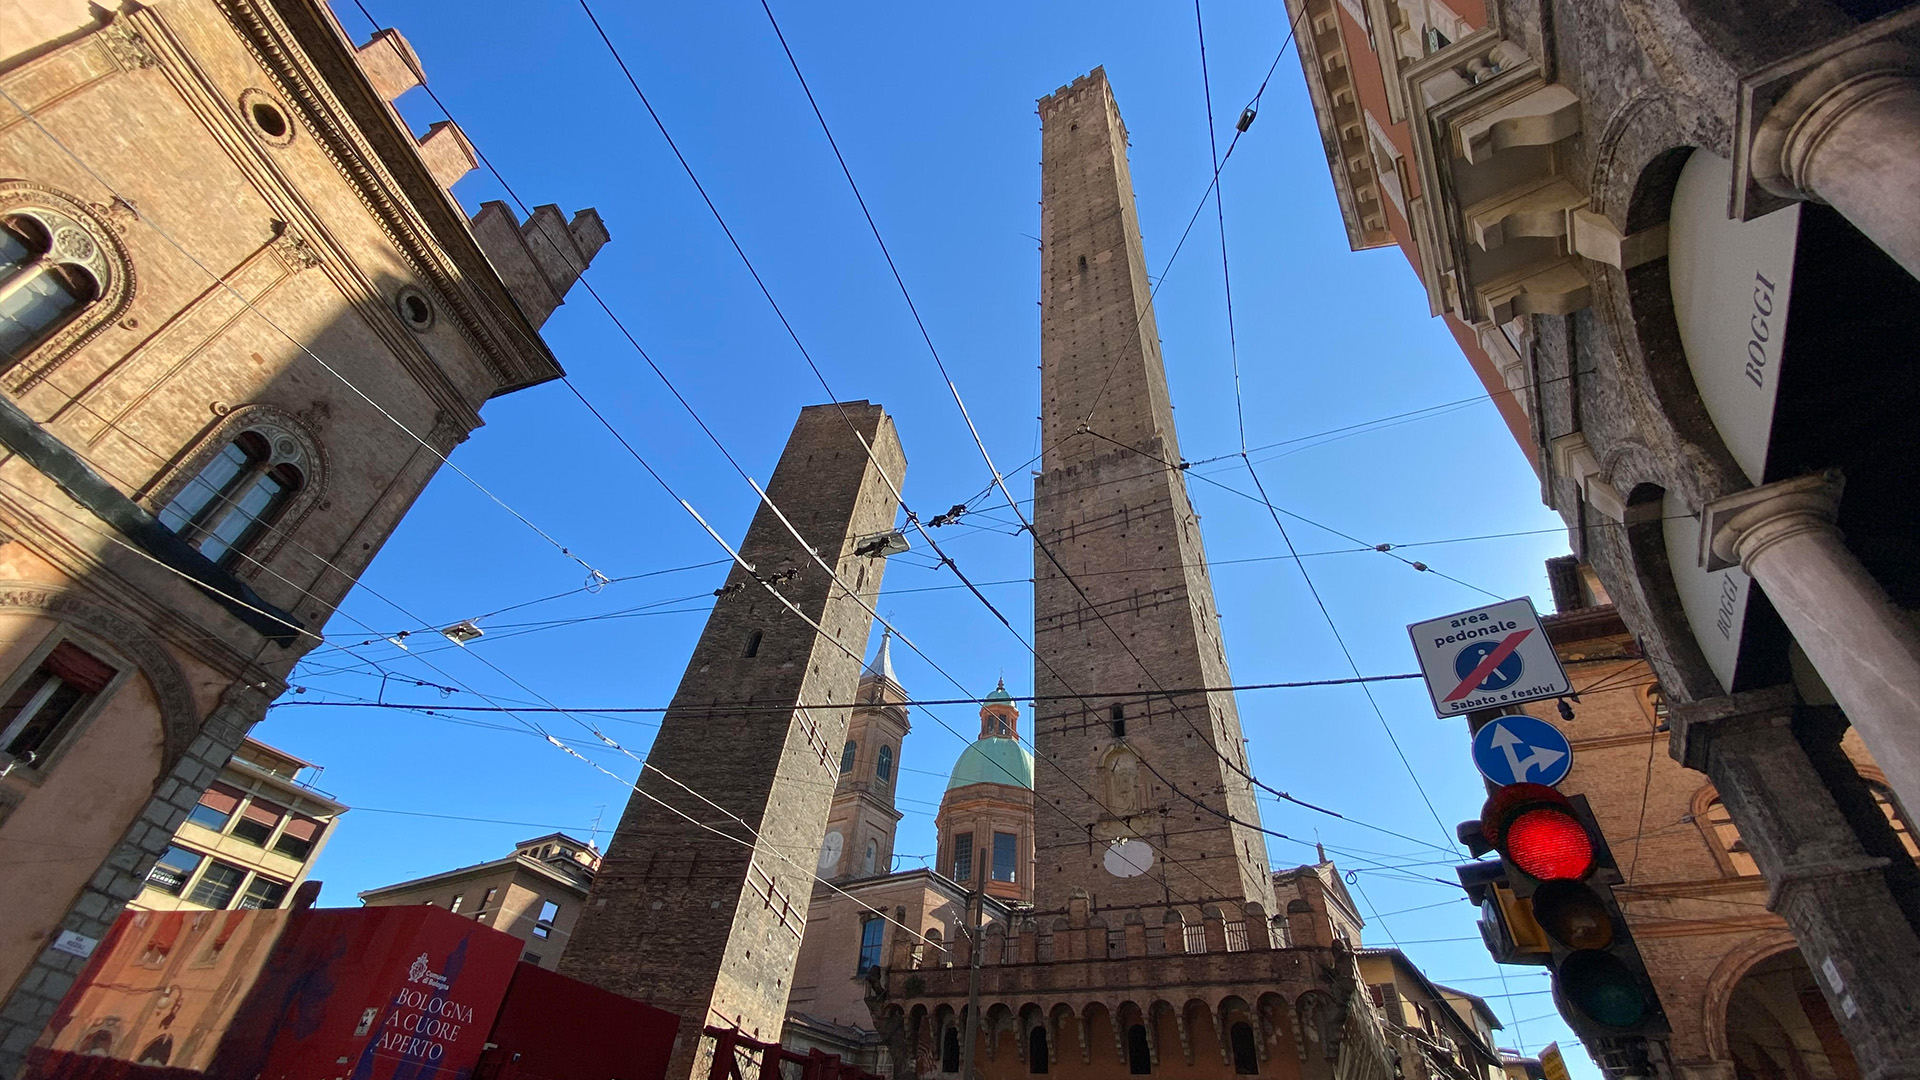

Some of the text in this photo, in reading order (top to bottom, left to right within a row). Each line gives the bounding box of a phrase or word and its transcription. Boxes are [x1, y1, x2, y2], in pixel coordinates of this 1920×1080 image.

[1745, 269, 1776, 391] BOGGI
[1450, 612, 1490, 628] area
[1717, 572, 1738, 641] BOGGI
[1434, 620, 1517, 648] pedonale
[1451, 683, 1555, 711] Sabato e festivi
[426, 970, 447, 982] Comune
[428, 979, 450, 991] Bologna
[396, 987, 473, 1024] BOLOGNA
[386, 1010, 461, 1042] A CUORE
[375, 1031, 443, 1061] APERTO
